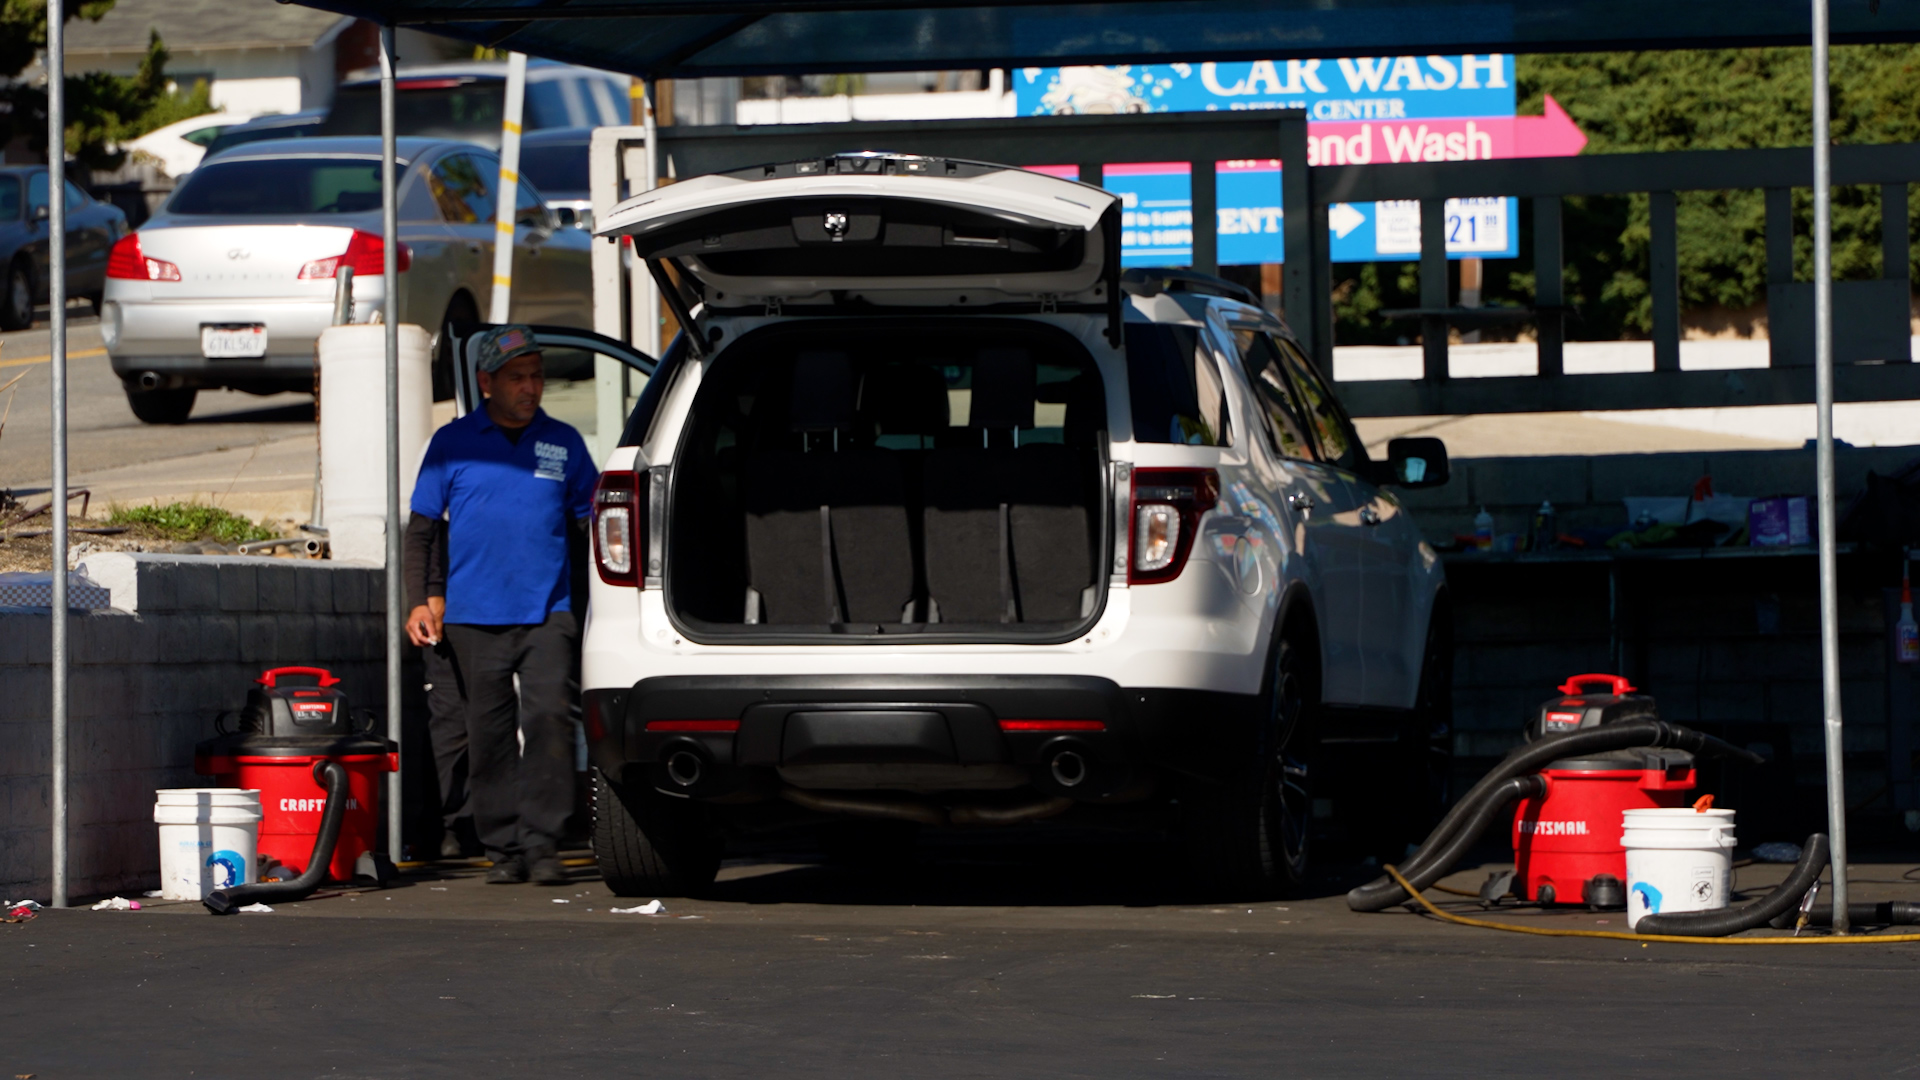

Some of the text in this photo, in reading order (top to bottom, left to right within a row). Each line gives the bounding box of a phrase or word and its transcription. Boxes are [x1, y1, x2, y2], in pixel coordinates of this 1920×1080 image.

[1201, 54, 1508, 97] CAR WASH
[1313, 98, 1406, 120] CENTER
[1306, 121, 1493, 167] and Wash
[280, 798, 358, 812] CRAFTAN
[1518, 819, 1587, 836] CRAFTSMAN
